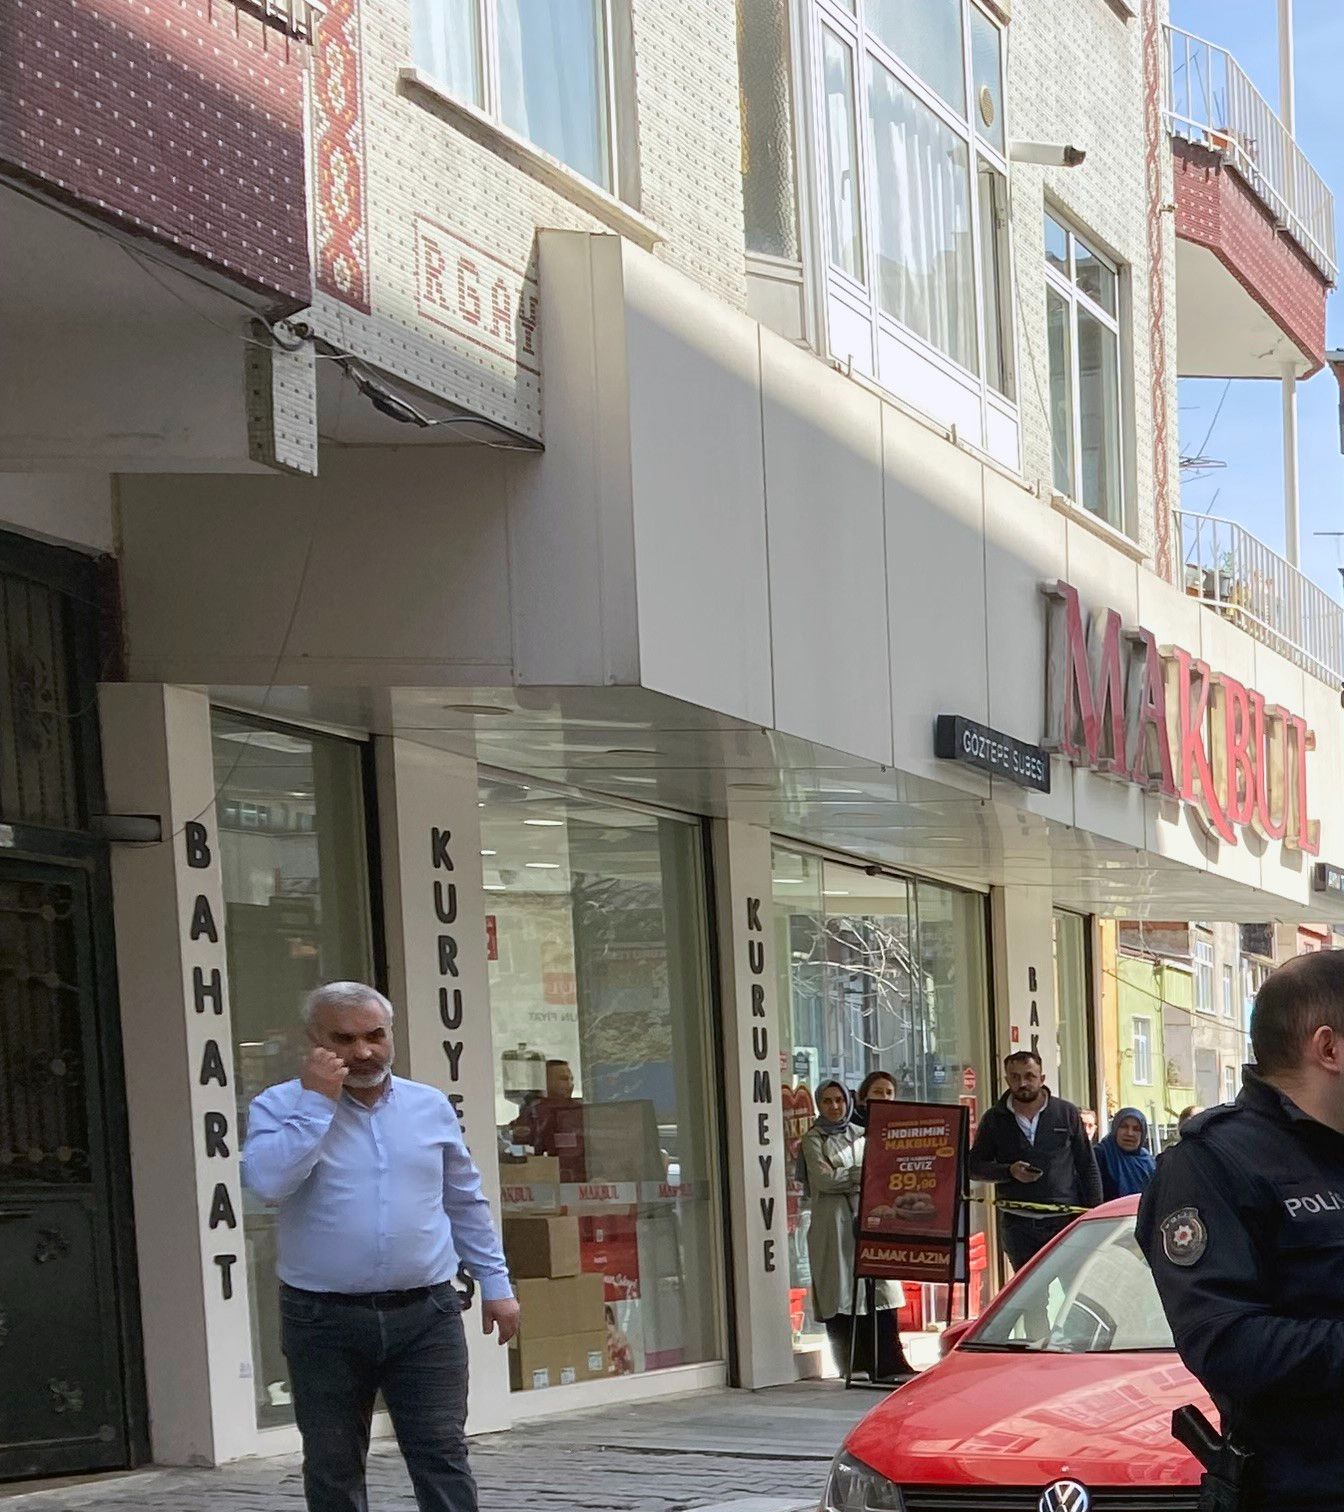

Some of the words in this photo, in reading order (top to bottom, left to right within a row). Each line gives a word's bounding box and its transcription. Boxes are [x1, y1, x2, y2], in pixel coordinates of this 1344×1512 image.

[1052, 578, 1321, 858] MAKBUL
[185, 821, 237, 1300] BAHARAT
[746, 897, 776, 1273] KURUMEYVE
[861, 1247, 908, 1262] ALMAK
[909, 1250, 951, 1266] LAZIM
